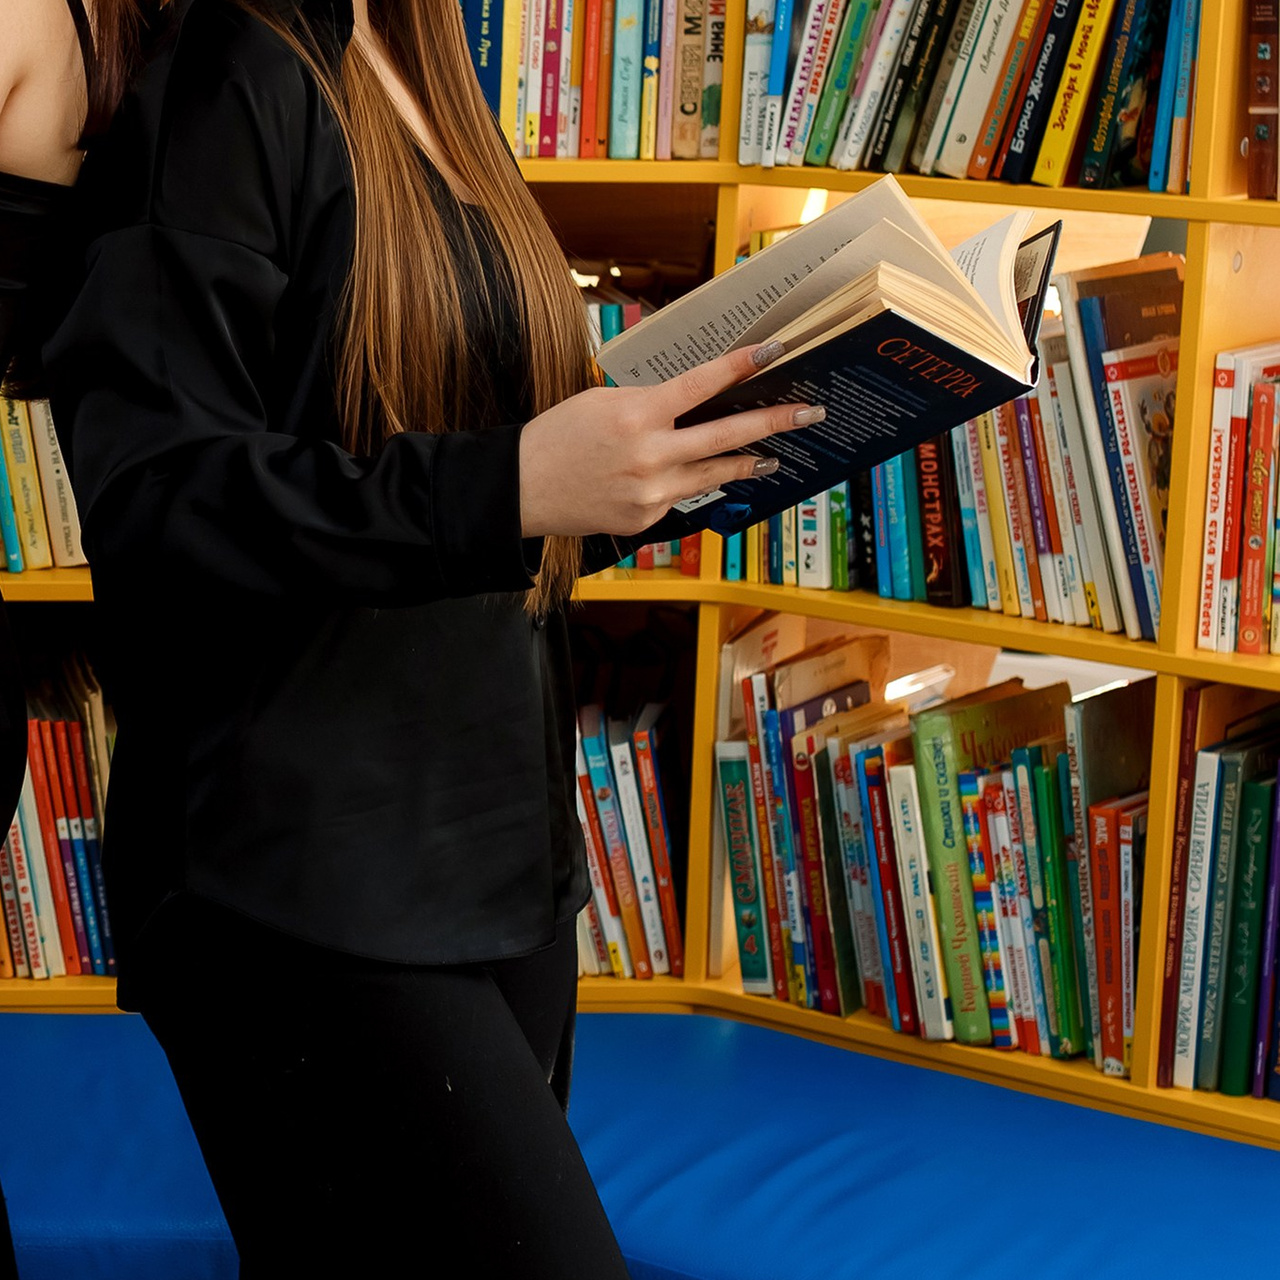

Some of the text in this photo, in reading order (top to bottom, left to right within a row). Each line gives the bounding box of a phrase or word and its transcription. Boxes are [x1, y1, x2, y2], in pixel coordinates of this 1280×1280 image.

[478, 39, 490, 67] Луне
[707, 22, 723, 63] Эмма
[809, 28, 834, 95] ПРАЗДНИК
[902, 40, 918, 67] НОВЫЕ
[1010, 100, 1035, 154] Борис
[1026, 33, 1056, 98] Житков
[1052, 76, 1078, 131] Зоопарк
[1074, 24, 1094, 58] моей
[783, 127, 799, 150] МЫ
[875, 337, 986, 399] СЕТЕРРА
[1112, 390, 1132, 456] РАССКАЗЫ
[920, 443, 944, 547] МОНСТРАХ
[1208, 429, 1224, 513] ЧЕЛОВЕКОМ!
[1206, 521, 1217, 555] БУДЬ
[801, 797, 824, 915] НОВАЯ ИГРУШКА
[938, 801, 957, 849] Стихи
[943, 863, 971, 949] Чуковский
[1175, 782, 1210, 1057] МОРИС МЕТЕРЛИНК СИНЯЯ ПТИЦА
[955, 954, 979, 1013] Корней
